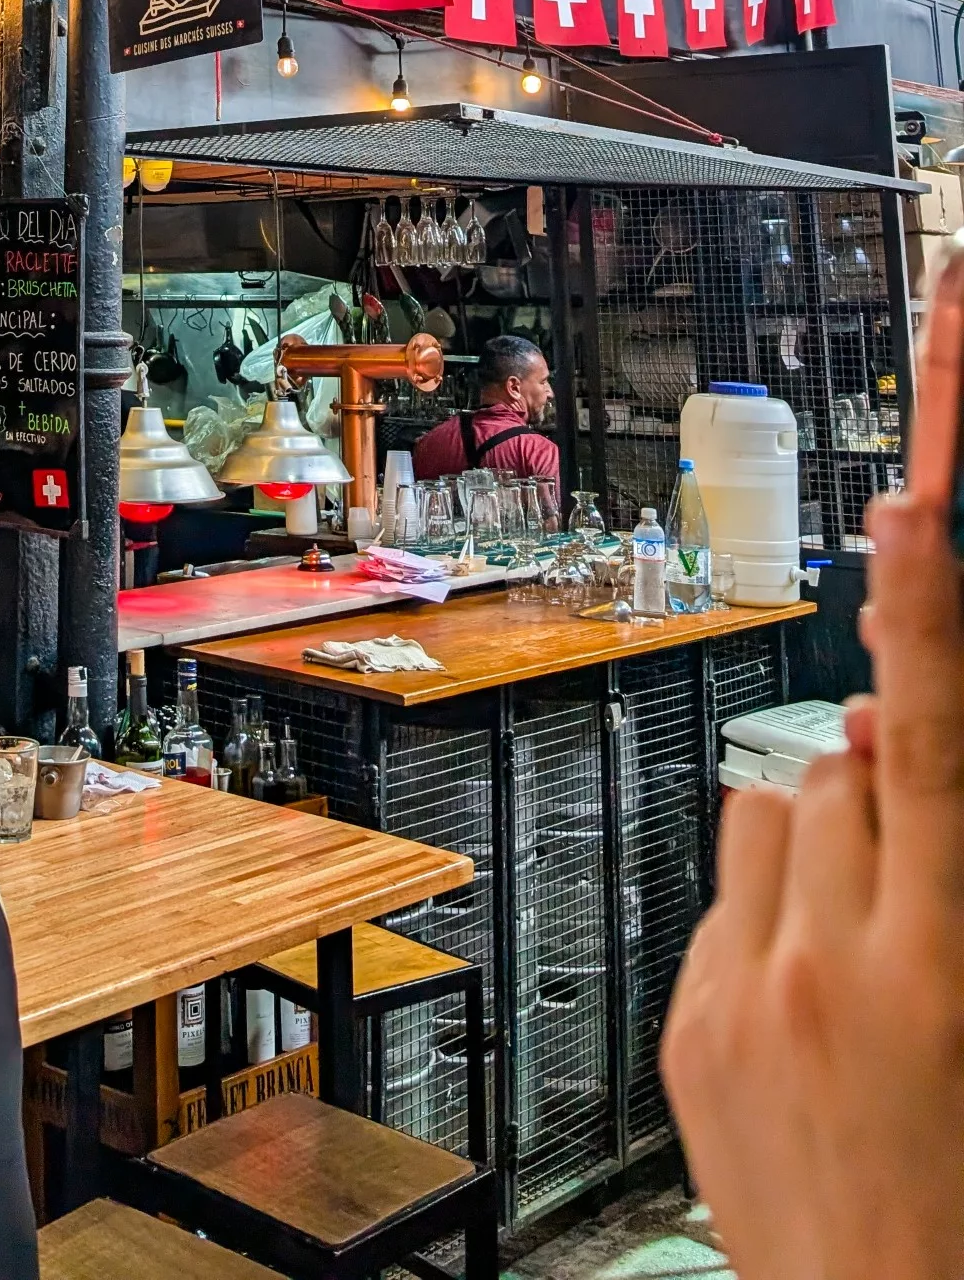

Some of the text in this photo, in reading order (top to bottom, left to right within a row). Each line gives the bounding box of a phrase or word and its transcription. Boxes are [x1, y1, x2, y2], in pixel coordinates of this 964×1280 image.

[133, 20, 234, 56] CUISINE DES MARCHÉS SUISSES
[18, 211, 44, 238] DEL
[5, 250, 77, 275] RACLETTE
[7, 278, 78, 298] BRUSCHETTA
[9, 352, 24, 372] DE
[34, 350, 77, 372] CERDO
[18, 377, 76, 397] SALTEADOS
[5, 431, 46, 444] EN EFECTIVO
[255, 1053, 315, 1104] BRANCA
